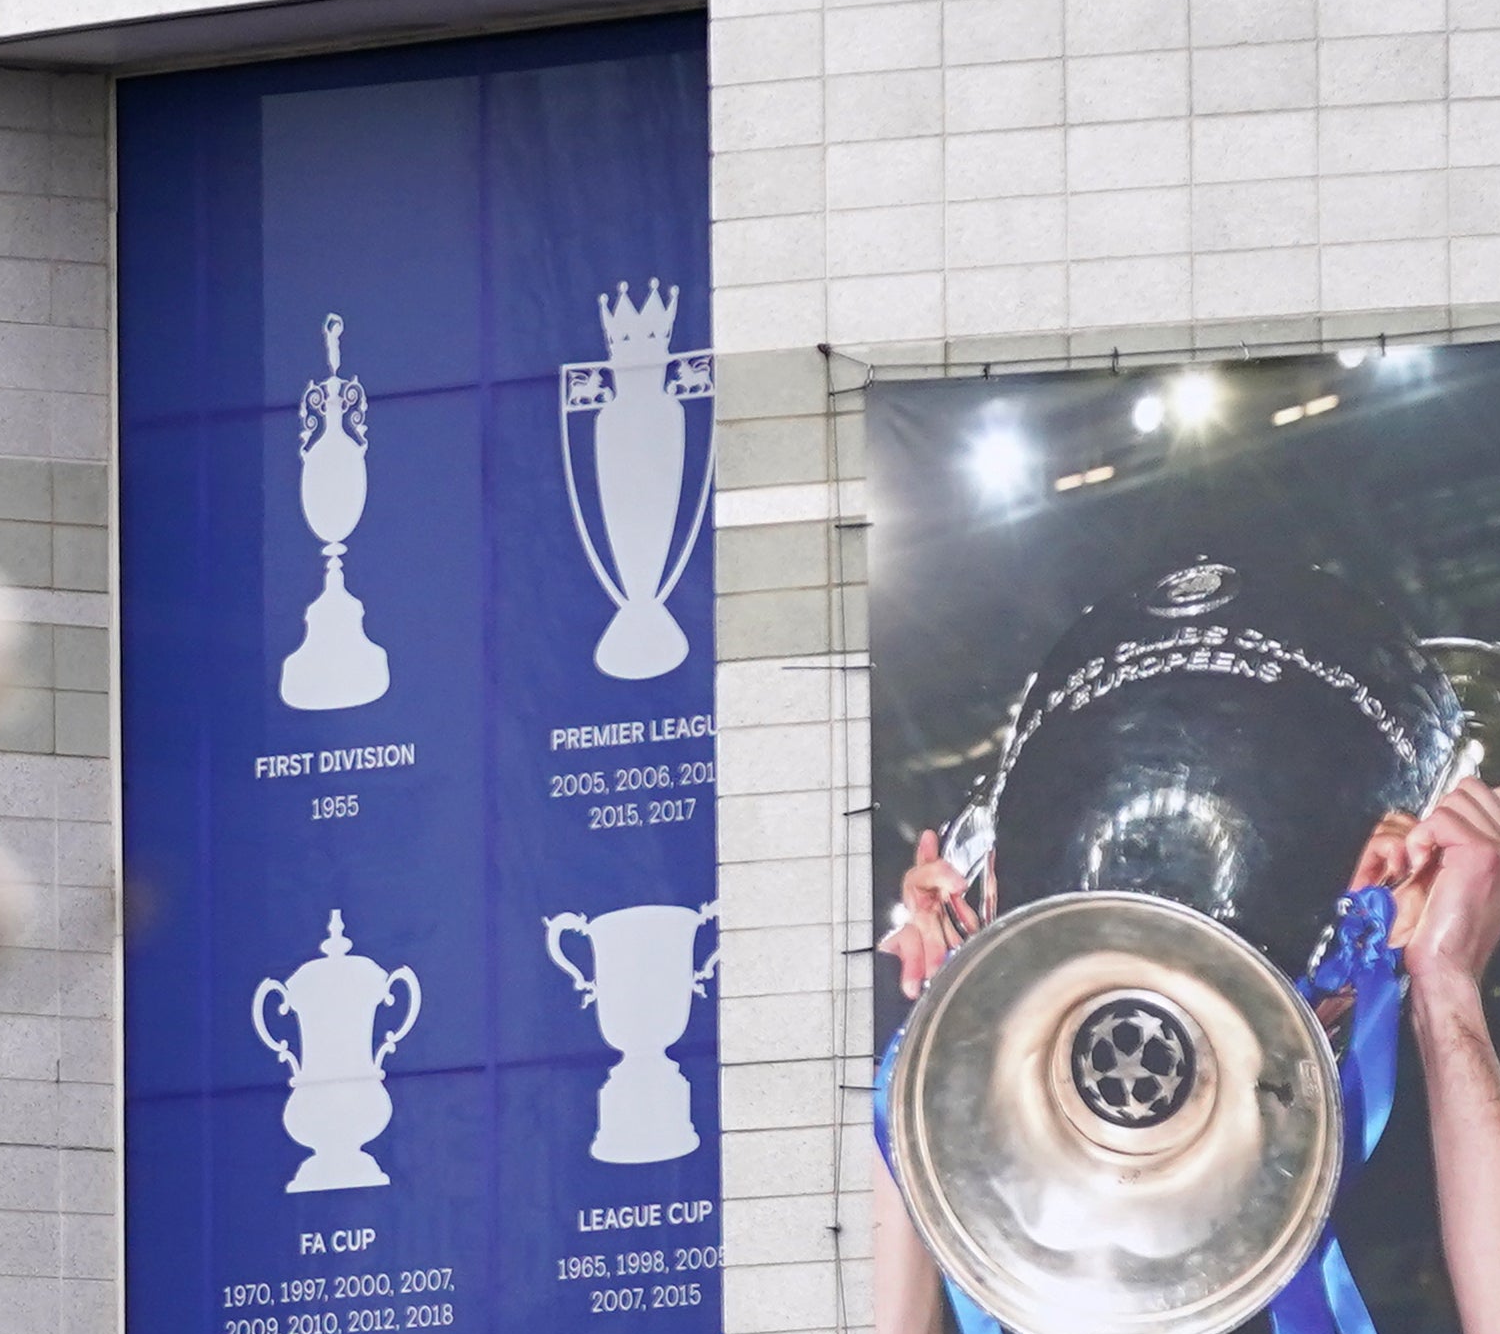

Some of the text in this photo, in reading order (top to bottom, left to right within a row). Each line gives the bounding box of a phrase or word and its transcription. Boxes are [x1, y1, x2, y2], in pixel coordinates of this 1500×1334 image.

[551, 714, 717, 750] PREMIER LEAGU
[256, 744, 414, 778] FIRST DIVISION
[551, 762, 715, 797] 2005, 2006, 201
[312, 795, 359, 819] 1955
[590, 798, 696, 829] 2015, 2017
[578, 1201, 712, 1232] LEAGUE CUP
[300, 1229, 375, 1255] FA CUP
[559, 1256, 610, 1279] 1965,
[617, 1250, 669, 1275] 1998,
[224, 1268, 454, 1307] 1970, 1997, 2000, 2007,
[592, 1284, 701, 1312] 2007, 2015
[348, 1308, 399, 1332] 2012,
[406, 1304, 453, 1327] 2018
